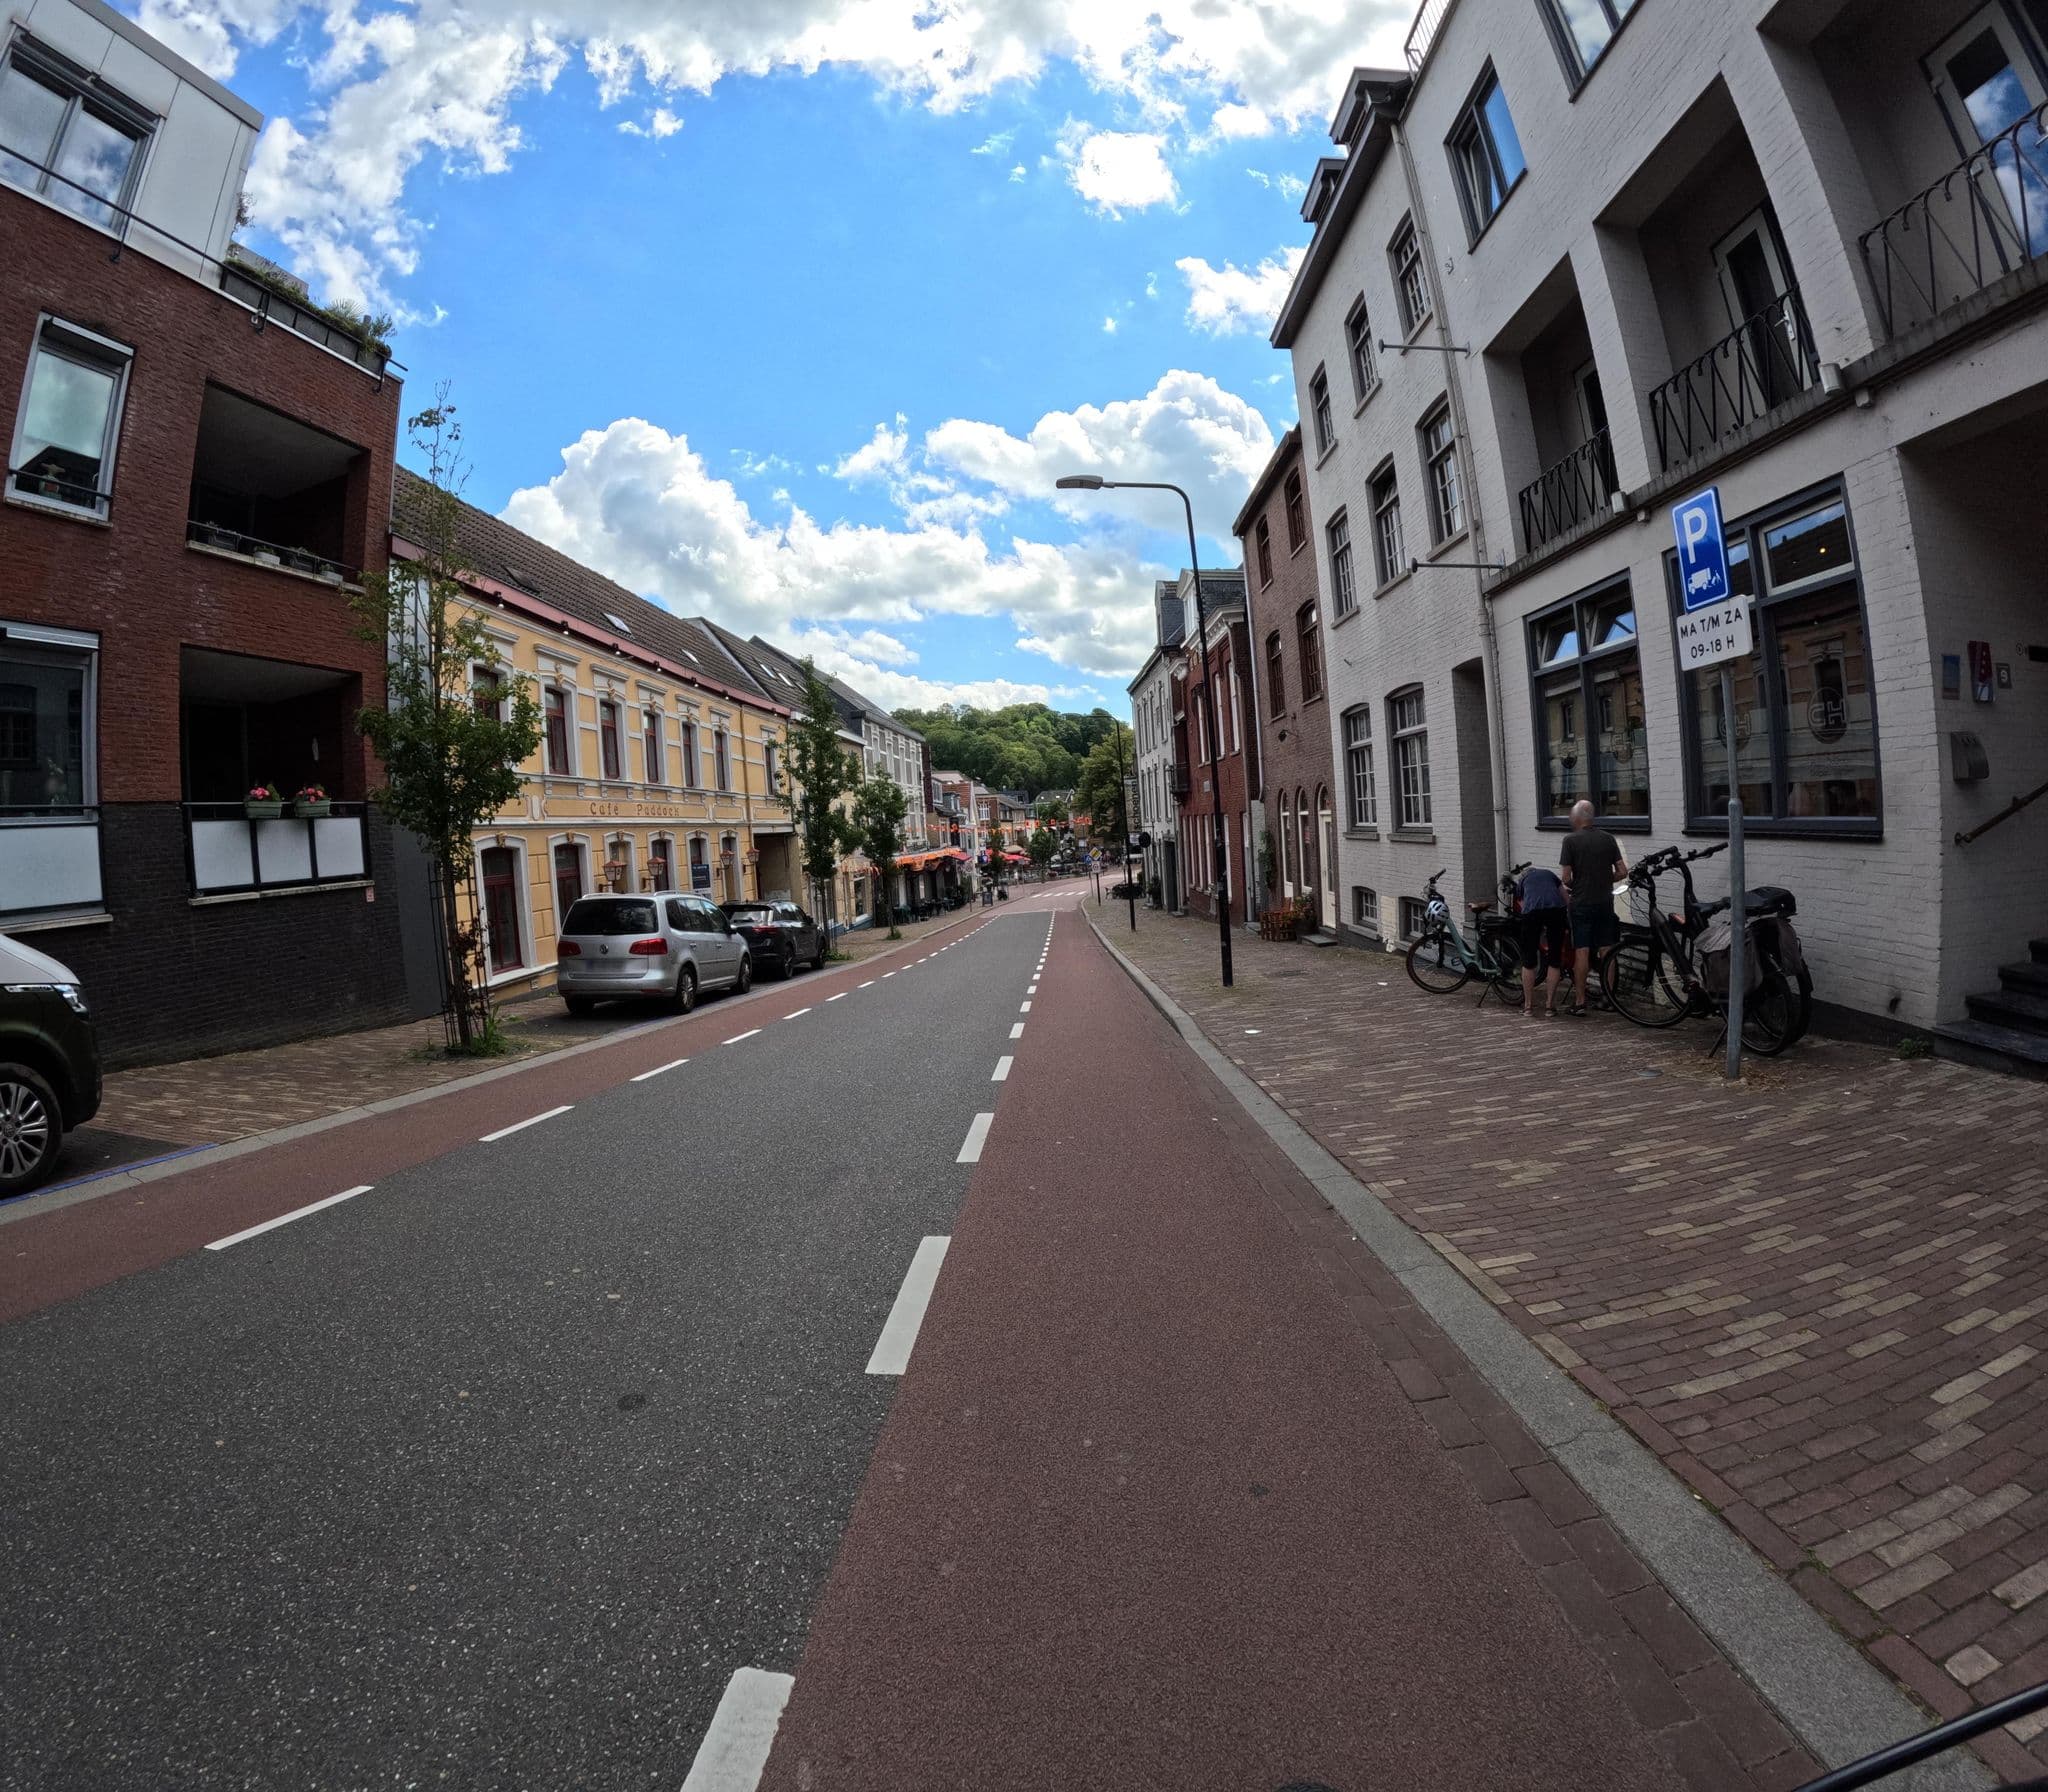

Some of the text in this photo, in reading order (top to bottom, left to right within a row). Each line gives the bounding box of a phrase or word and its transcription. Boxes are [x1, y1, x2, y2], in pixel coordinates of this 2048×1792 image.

[1682, 507, 1708, 564] P
[1680, 607, 1743, 639] MA T/M ZA
[1690, 634, 1735, 658] 09-18 H
